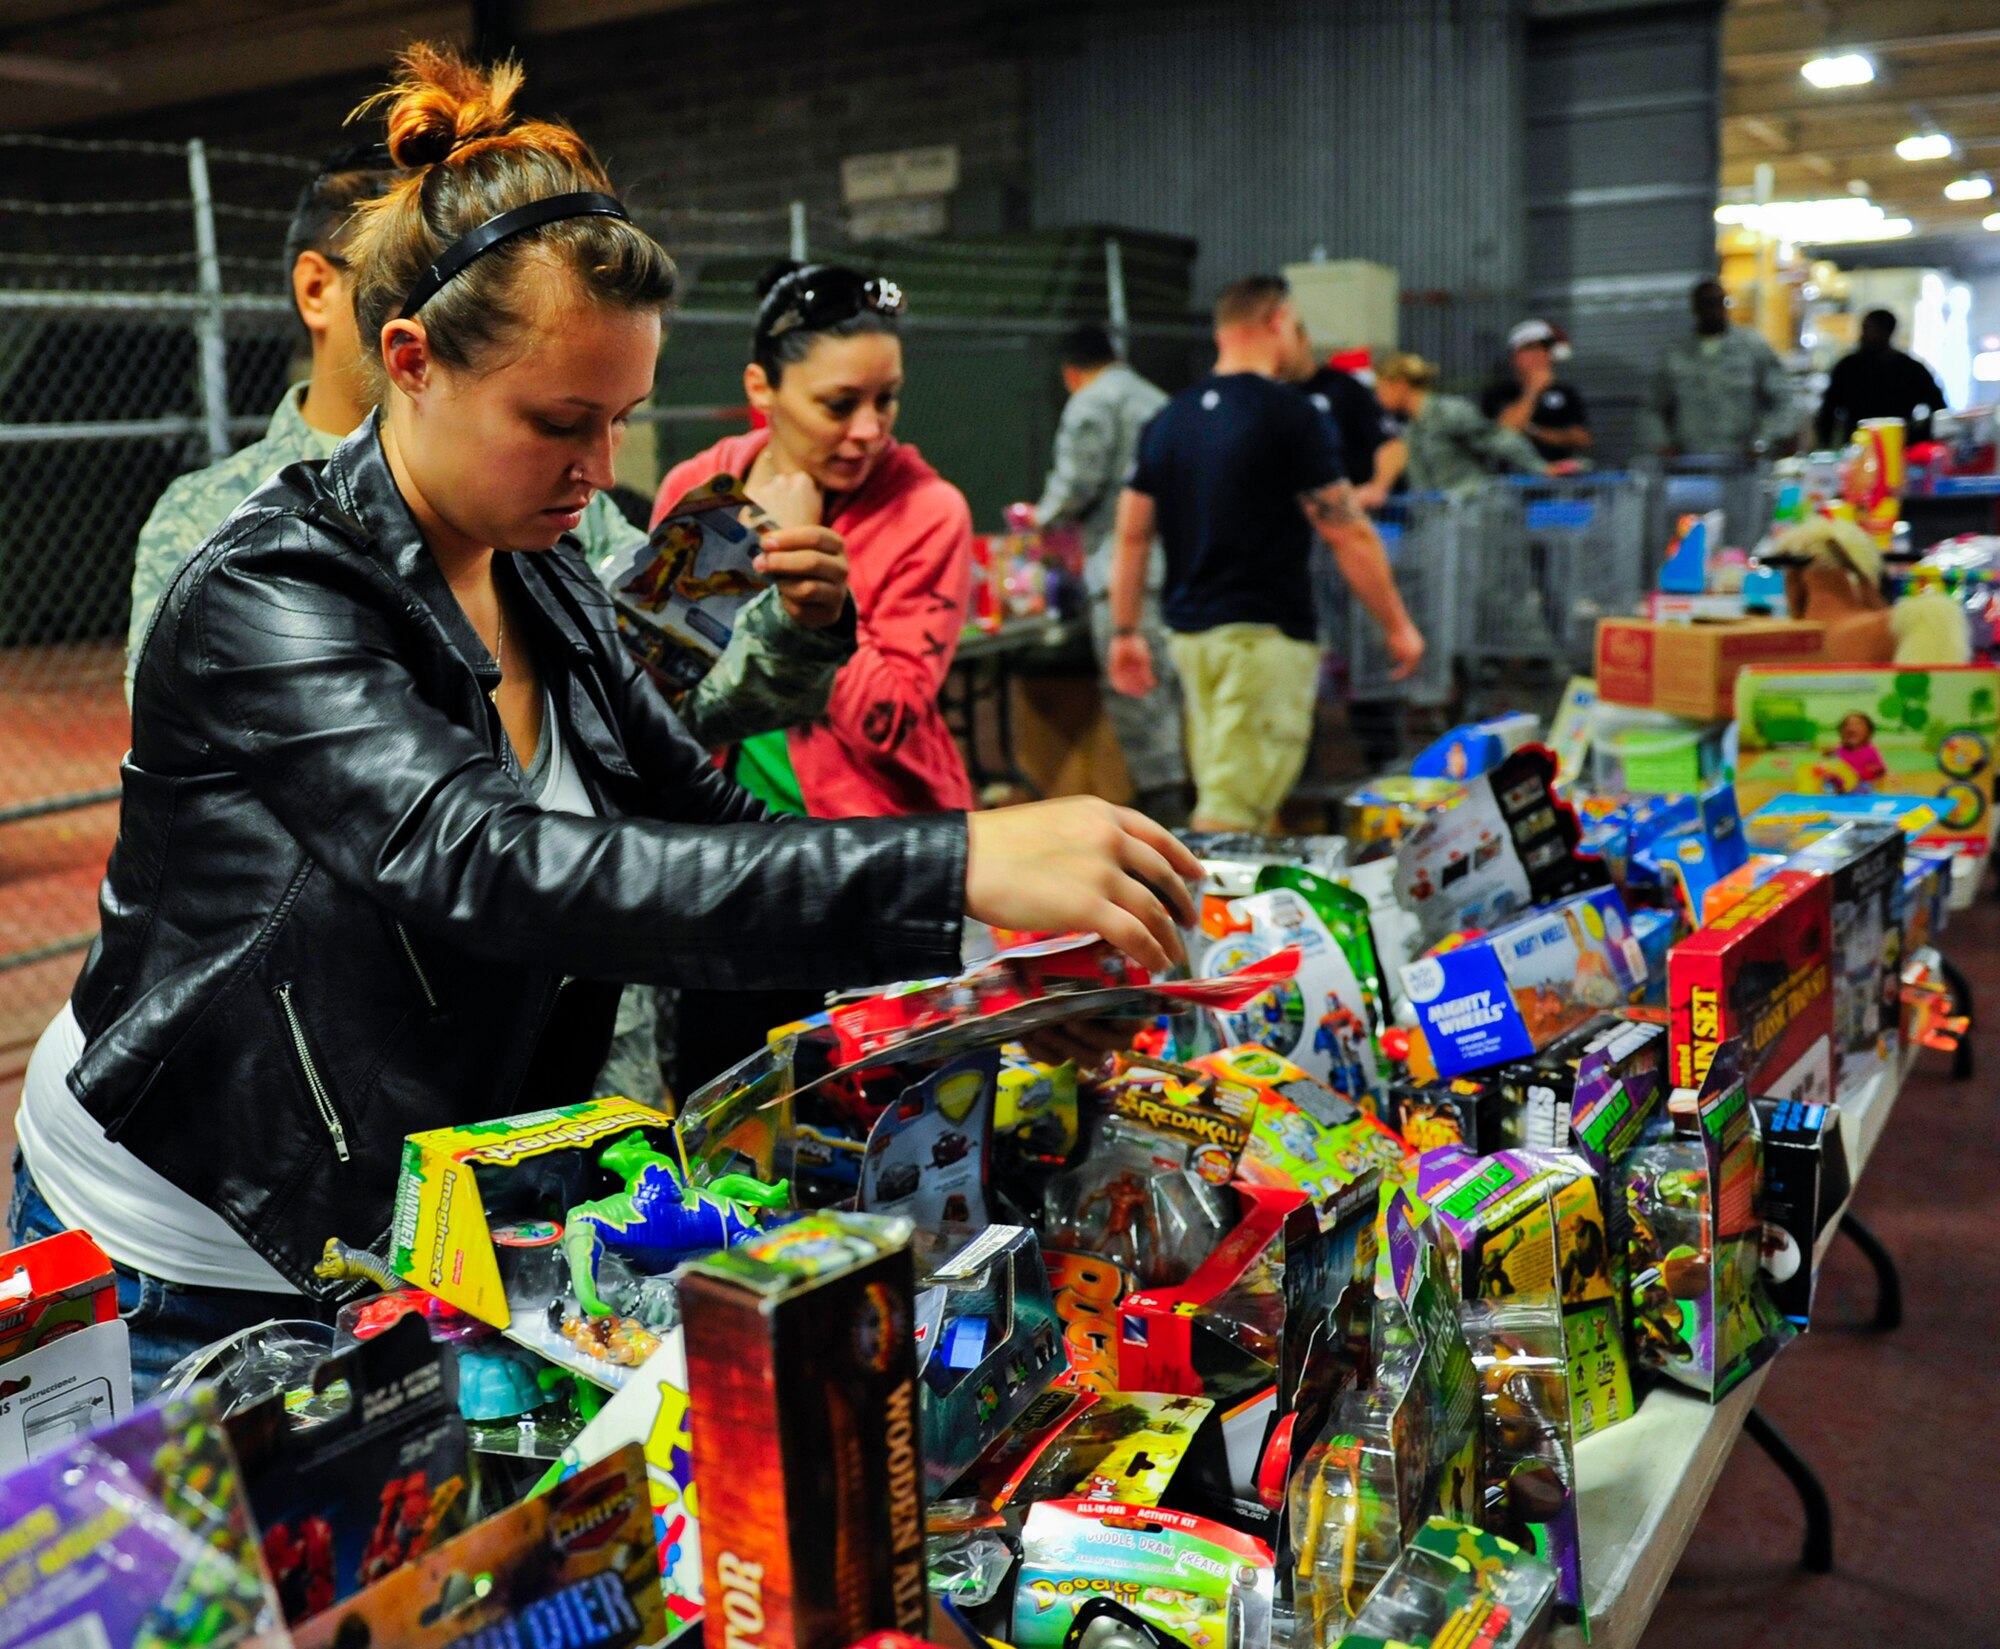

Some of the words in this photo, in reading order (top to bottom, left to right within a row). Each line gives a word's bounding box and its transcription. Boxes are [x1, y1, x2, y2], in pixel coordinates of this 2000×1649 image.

[1428, 990, 1491, 1023] MIGHTY
[1437, 1001, 1507, 1036] WHEELS
[1693, 985, 1718, 1039] SET
[1582, 1087, 1632, 1148] TURTLES
[1703, 1086, 1746, 1136] TURTLES
[472, 1114, 663, 1162] imaginext
[400, 1172, 423, 1251] HAMMER
[1436, 1162, 1515, 1219] TURTLES
[430, 1168, 457, 1289] imaginext
[19, 1376, 77, 1405] Instrucciones
[885, 1378, 918, 1553] WOODEN
[1077, 1503, 1126, 1514] ALL-IN-ONE
[1137, 1508, 1180, 1523] ACTIVITY
[1180, 1515, 1198, 1528] KIT
[1087, 1532, 1136, 1548] DOODLE,
[1140, 1537, 1175, 1558] DRAW,
[1178, 1550, 1227, 1578] CREATE!
[1030, 1577, 1142, 1614] Doodle
